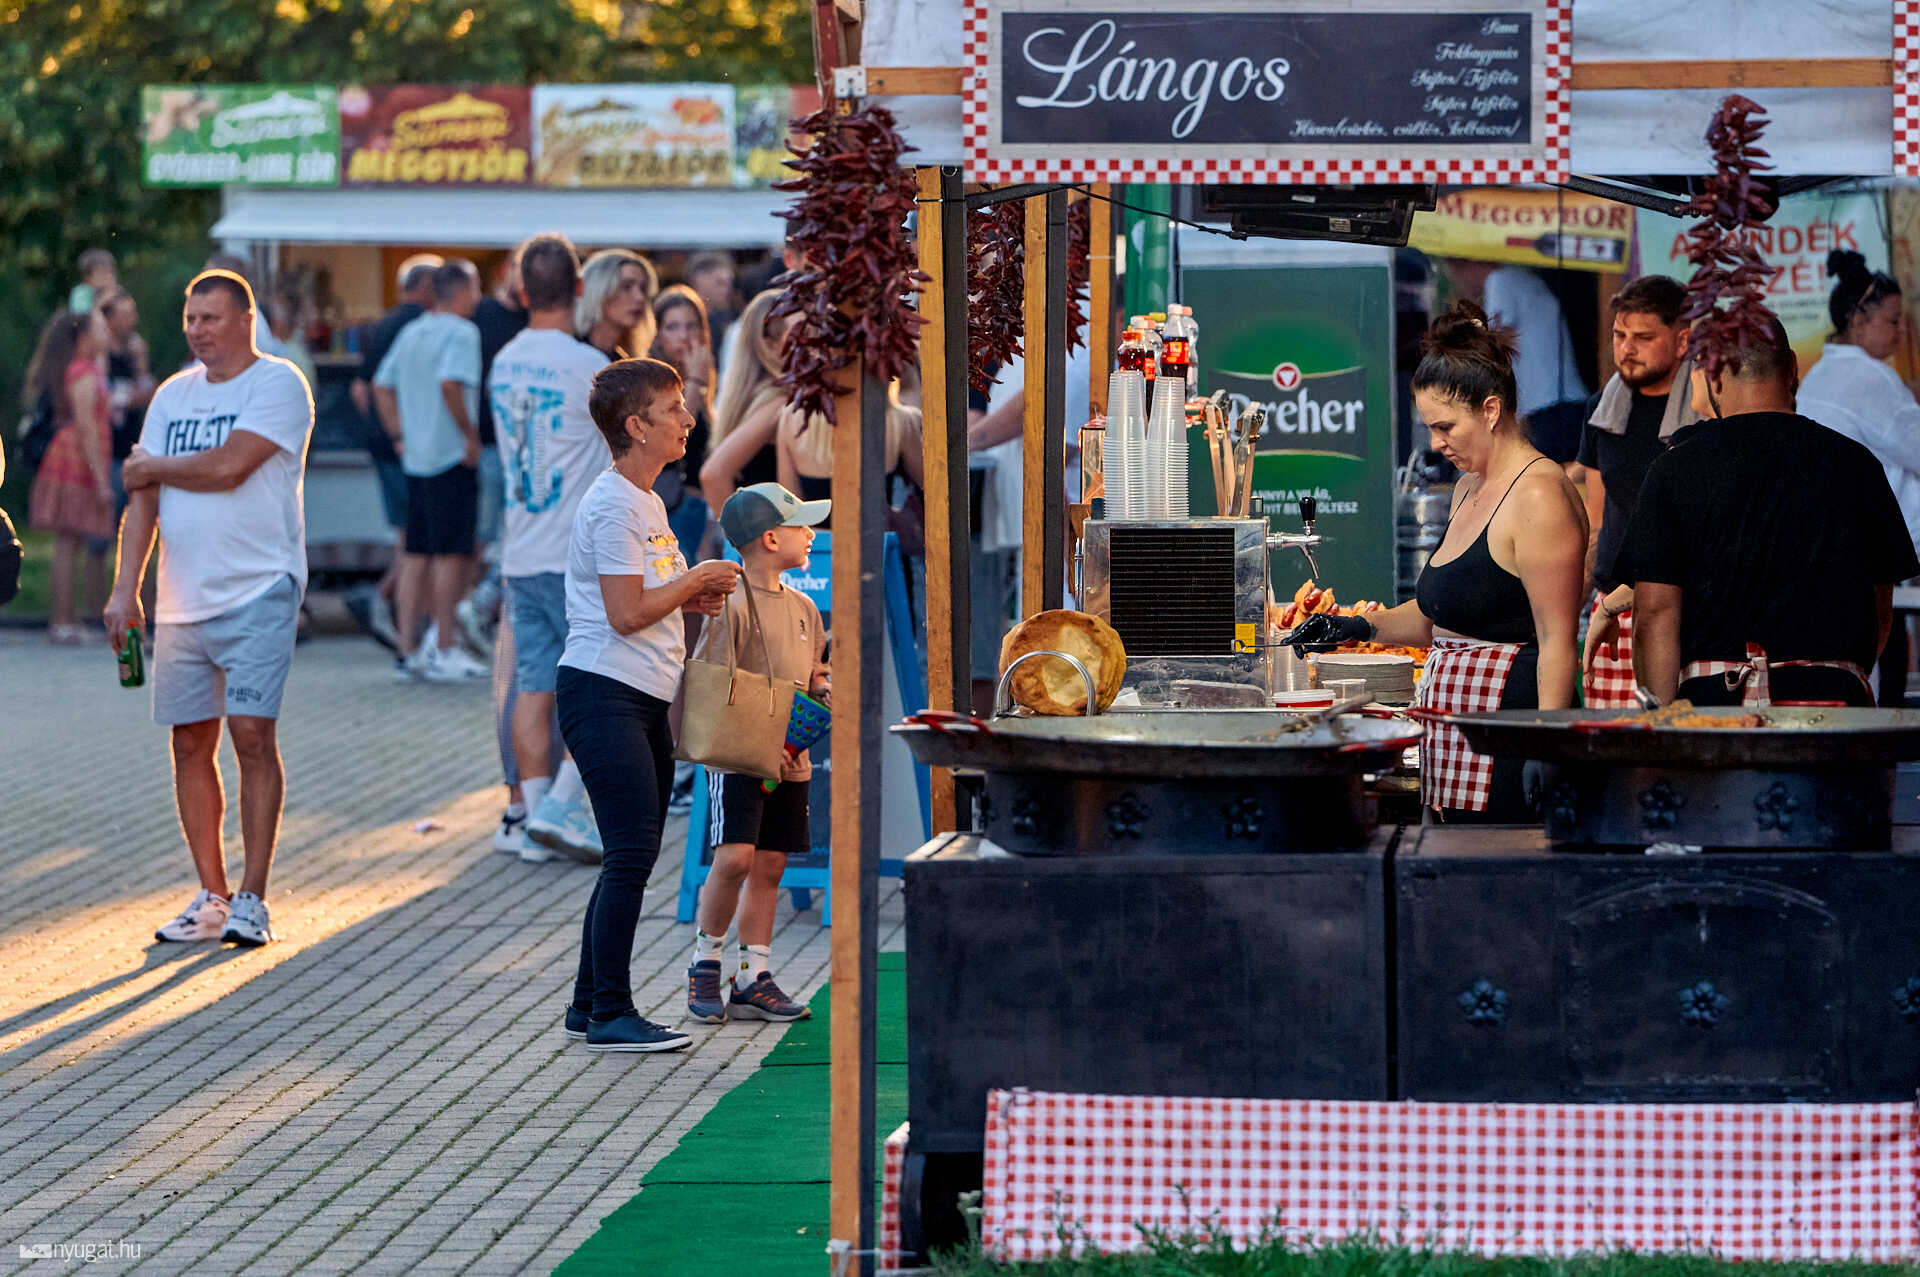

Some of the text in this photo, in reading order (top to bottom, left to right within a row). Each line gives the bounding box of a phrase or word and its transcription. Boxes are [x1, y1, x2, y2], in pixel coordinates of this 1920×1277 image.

[1016, 19, 1291, 138] Lángos
[1438, 194, 1627, 229] MEGGYBOR
[1228, 387, 1364, 442] Dreher
[781, 570, 829, 592] Dreher
